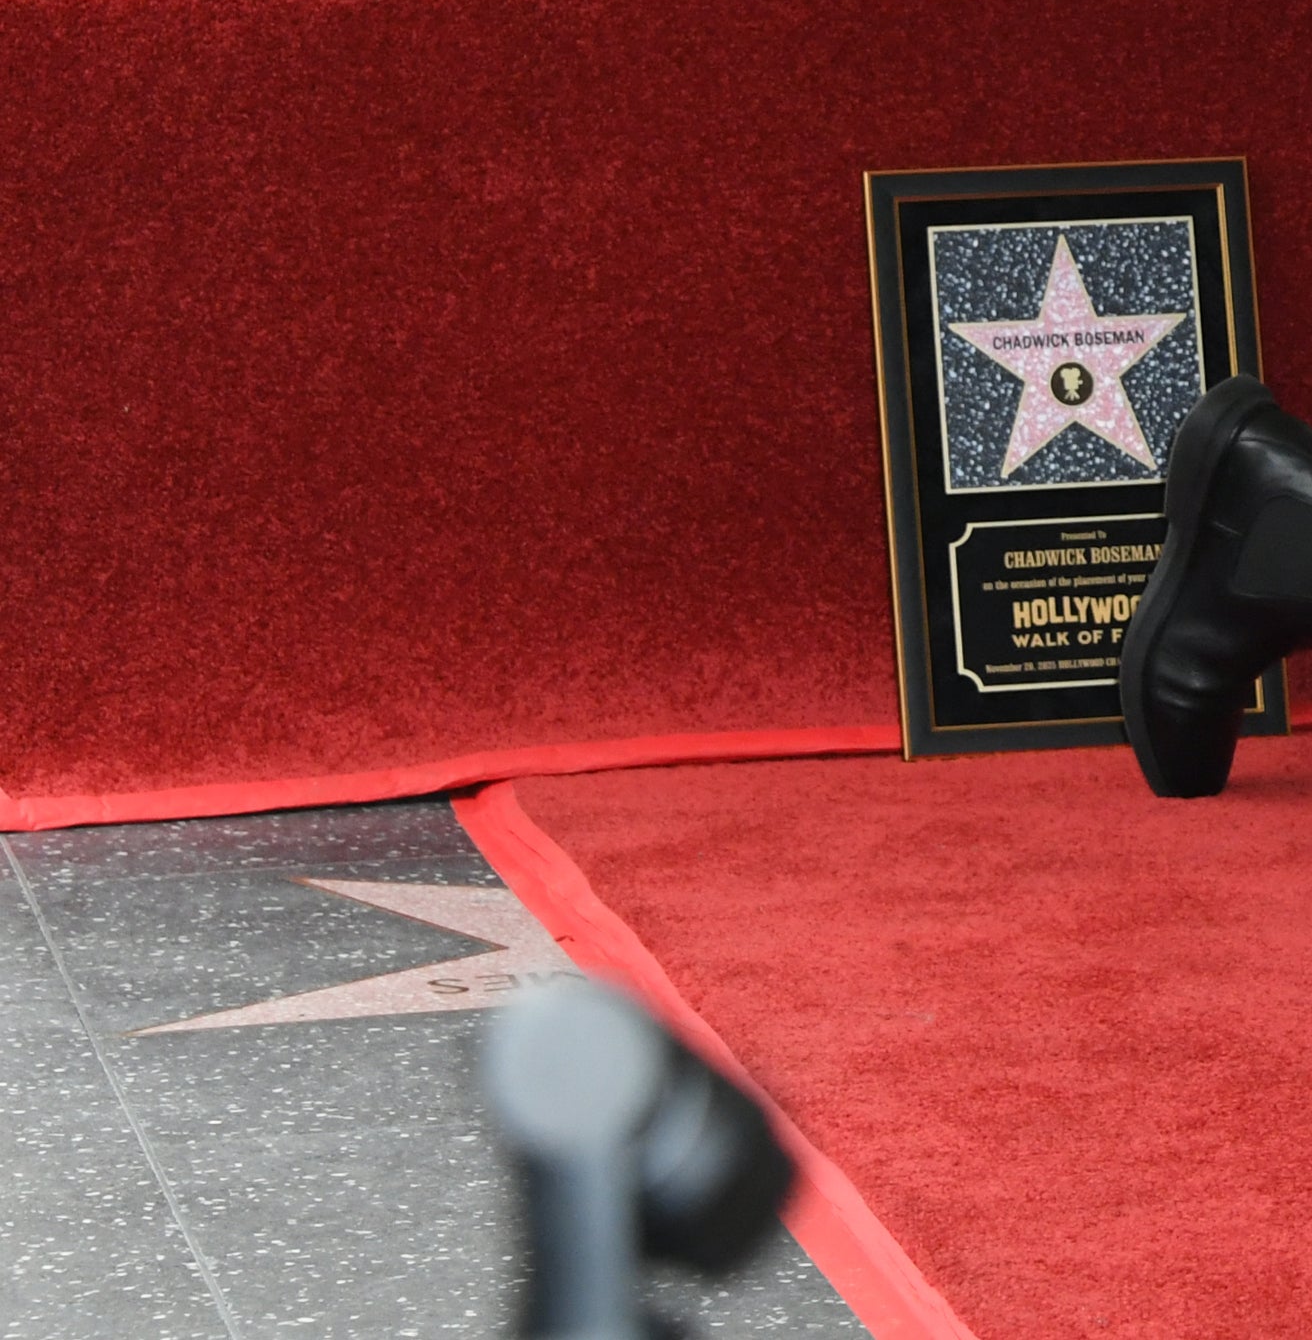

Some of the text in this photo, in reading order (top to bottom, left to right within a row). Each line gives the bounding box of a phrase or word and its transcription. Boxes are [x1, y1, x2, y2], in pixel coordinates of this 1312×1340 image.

[993, 330, 1145, 350] CHADWICK BOSEMAN
[1004, 544, 1165, 569] CHADWICK BOSEMAN
[1058, 577, 1071, 587] the
[1011, 628, 1124, 648] WALK OF F
